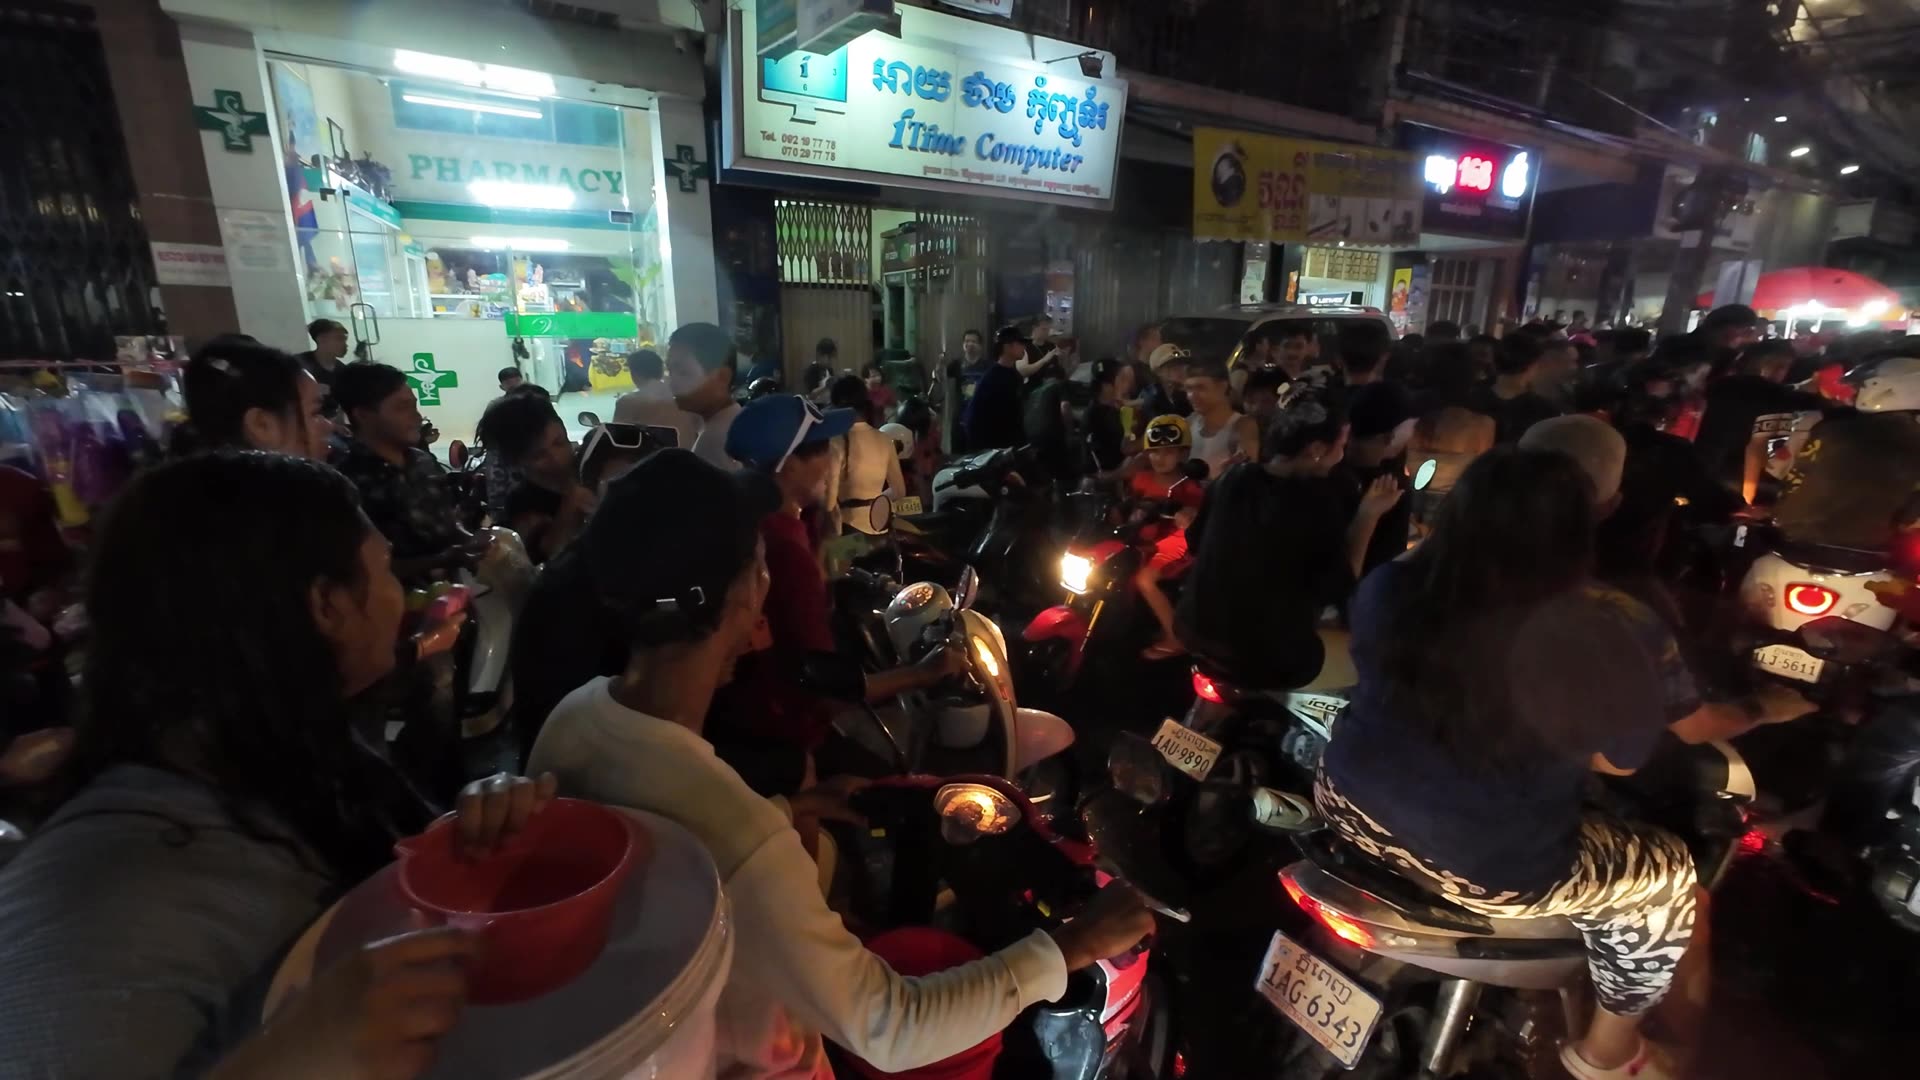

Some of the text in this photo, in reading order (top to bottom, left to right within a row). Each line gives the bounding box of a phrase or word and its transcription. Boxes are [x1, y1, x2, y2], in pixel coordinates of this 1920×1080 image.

[803, 84, 808, 92] 6
[781, 146, 798, 157] 070
[812, 150, 823, 159] 77
[825, 151, 836, 161] 78
[813, 138, 824, 148] 77
[825, 139, 836, 150] 78
[975, 132, 1084, 175] Computer
[407, 153, 622, 195] PHARMACY
[1264, 961, 1362, 1048] 1AG-6343
